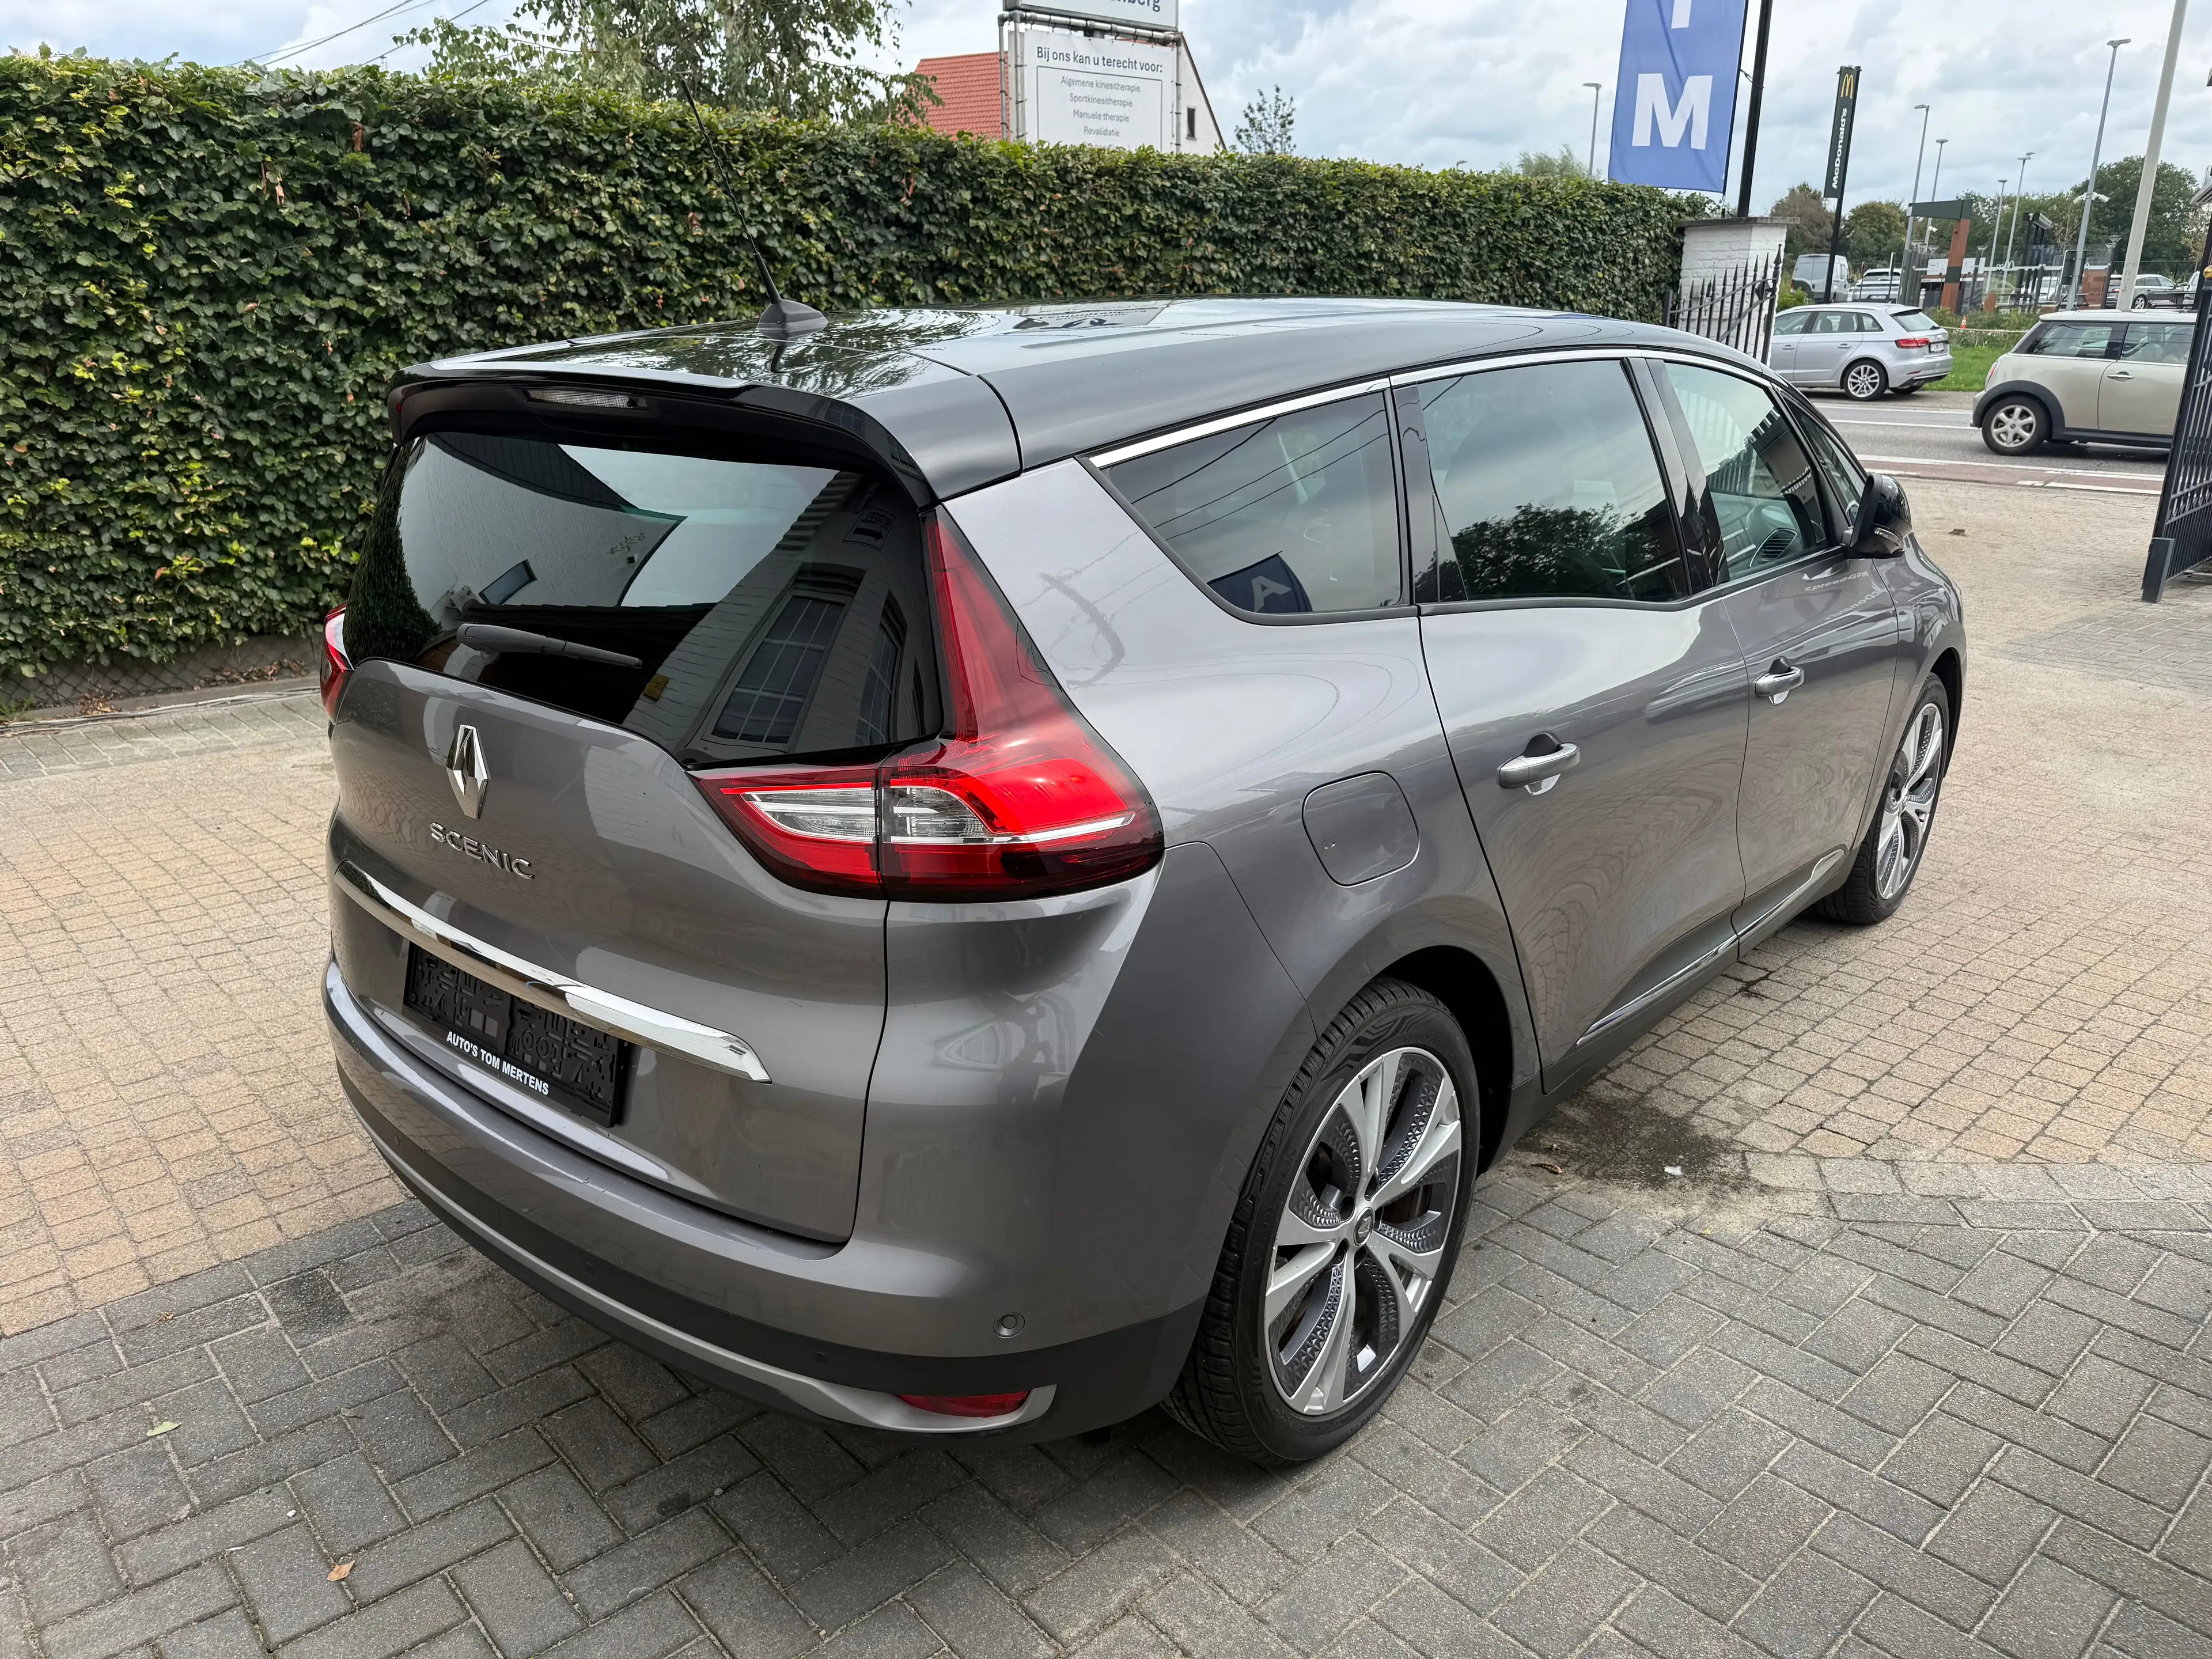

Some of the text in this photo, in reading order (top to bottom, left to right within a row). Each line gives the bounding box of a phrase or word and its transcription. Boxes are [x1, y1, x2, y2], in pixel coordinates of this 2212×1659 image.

[1037, 46, 1162, 73] Bij ons kan u terecht voor:
[1060, 76, 1141, 93] Algemene kinesitherapie
[1069, 93, 1132, 108] Sportkinesitherapie
[1073, 109, 1129, 123] Manuele therapie
[1084, 126, 1120, 137] Revalidatie
[1832, 108, 1847, 190] McDonald's
[430, 822, 535, 880] SCENIC
[446, 1031, 549, 1096] AUTO'S TOM MERTENS
